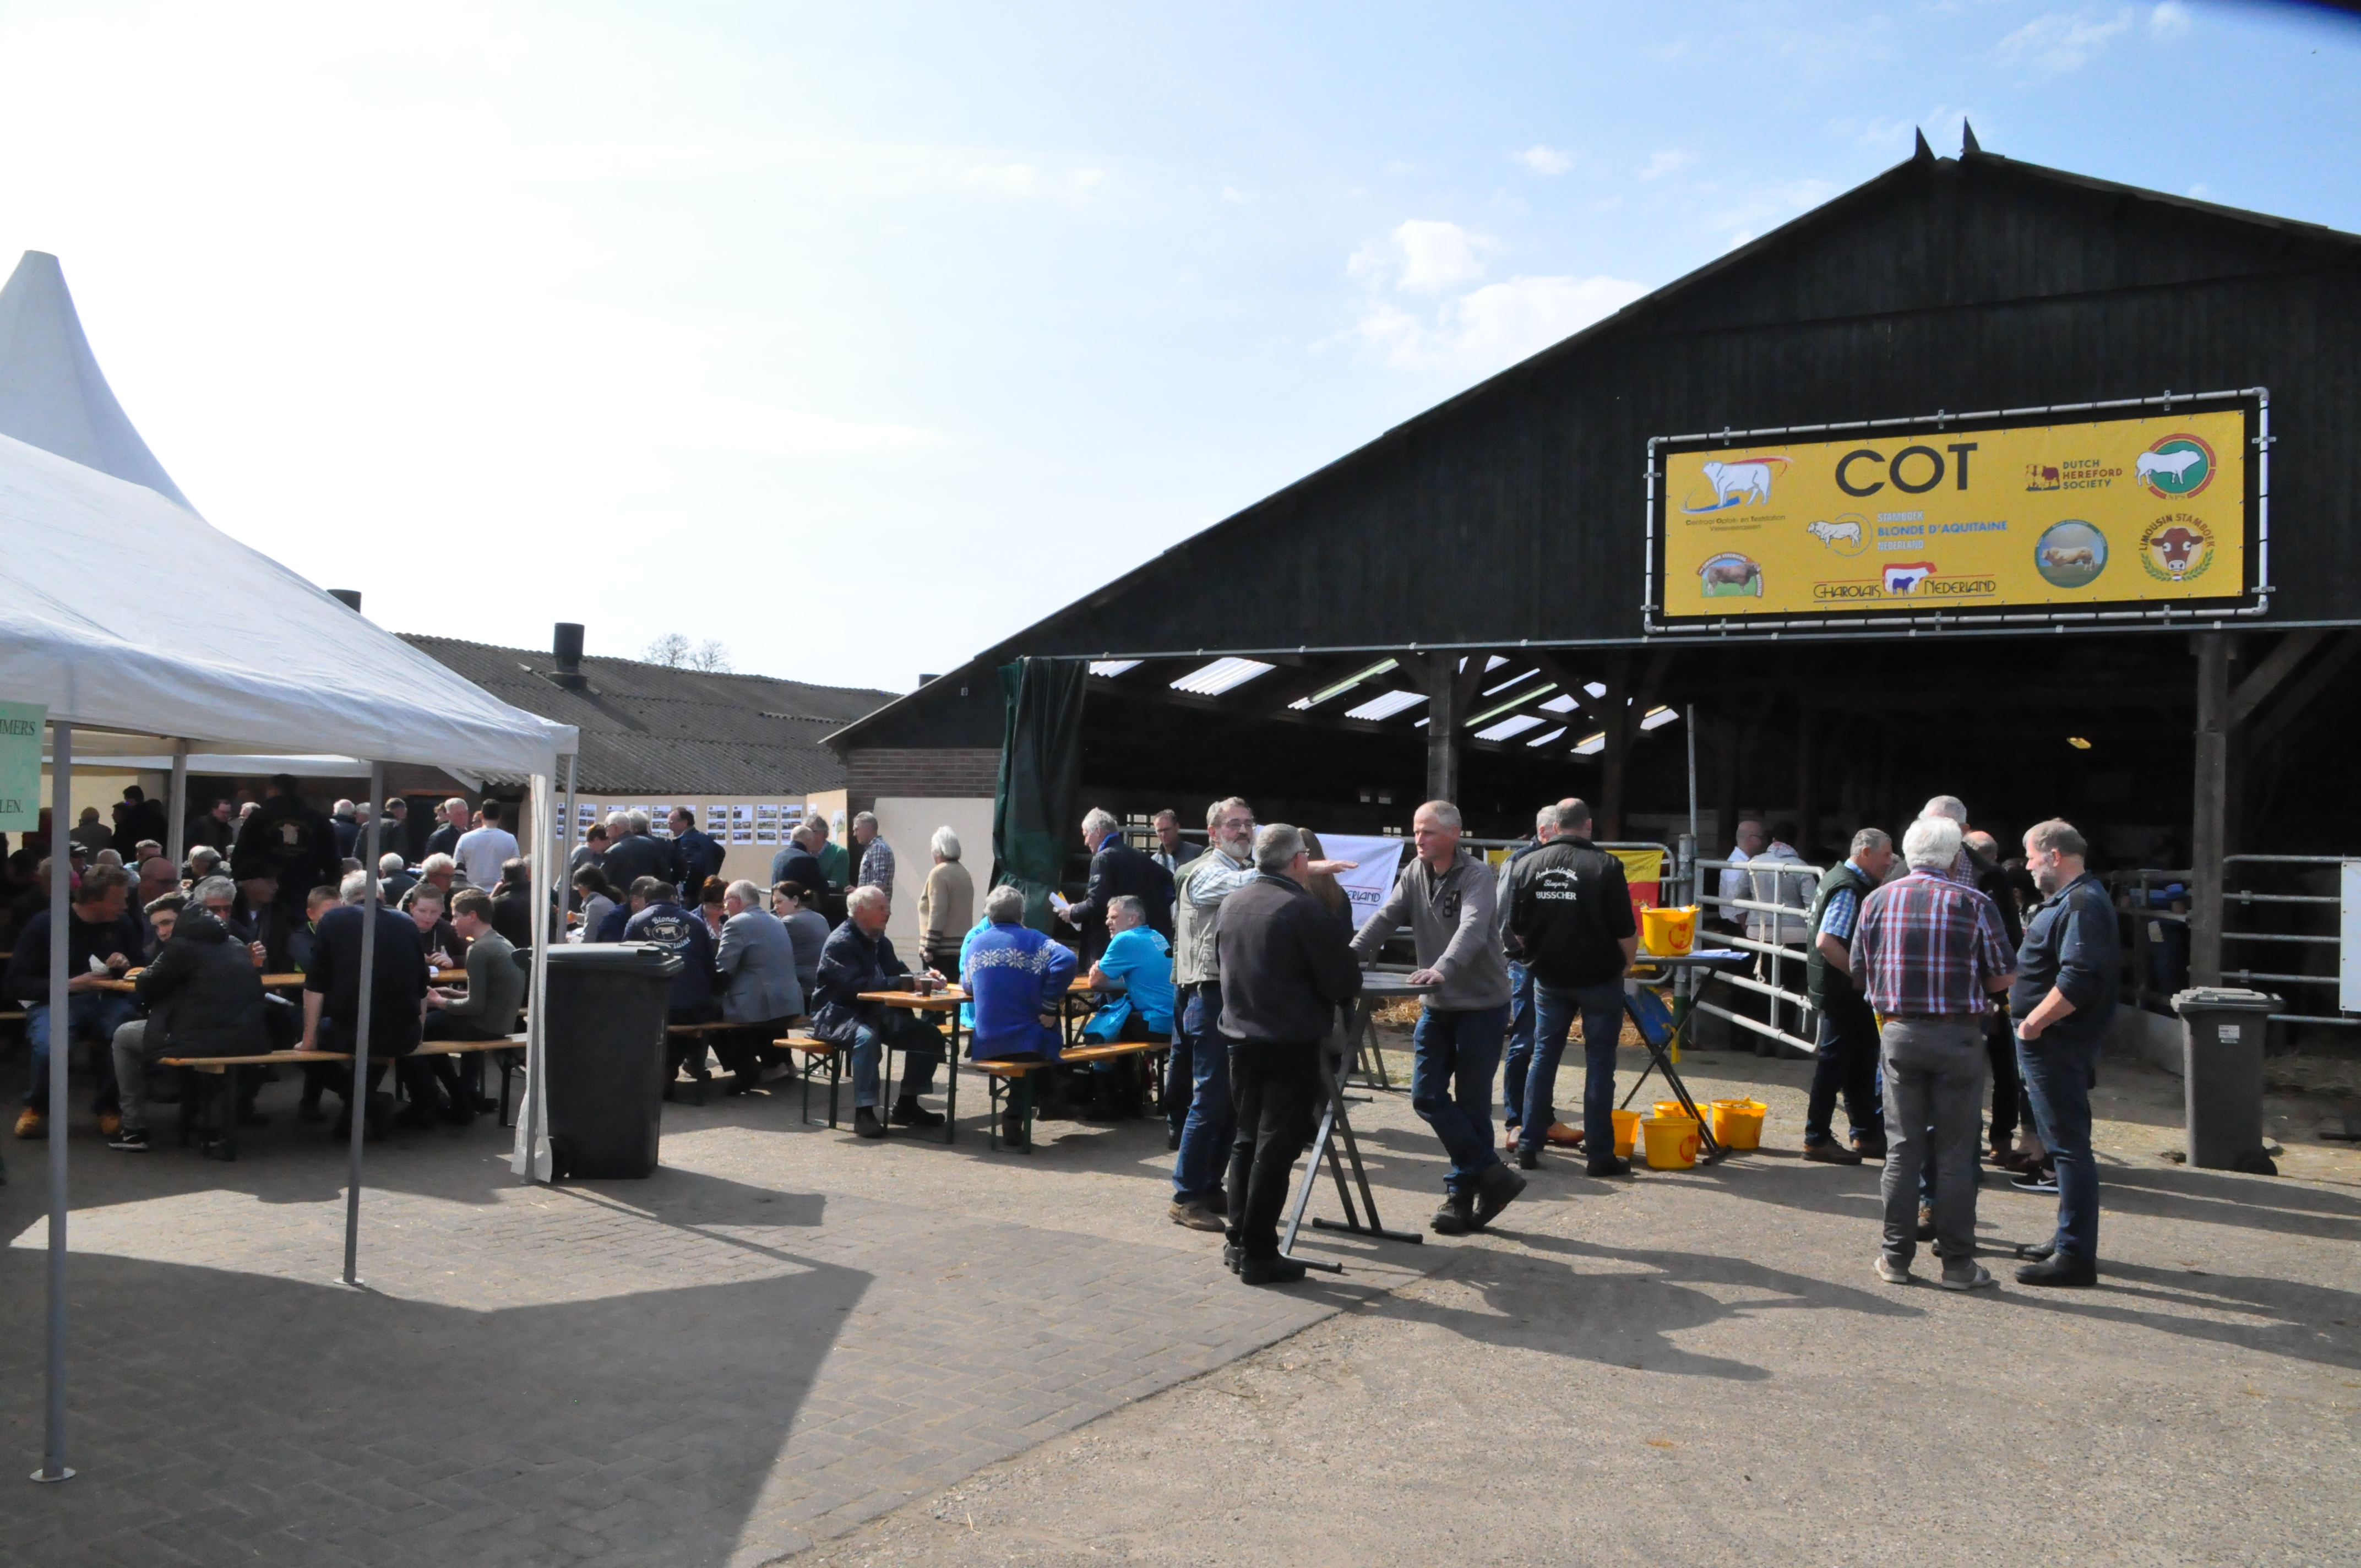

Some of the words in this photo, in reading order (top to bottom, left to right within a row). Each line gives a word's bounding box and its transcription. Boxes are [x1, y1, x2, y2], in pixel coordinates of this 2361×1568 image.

[1835, 443, 1978, 497] COT
[2063, 459, 2100, 469] DUTCH
[2063, 468, 2123, 480] HEREFORD
[2063, 479, 2111, 489] SOCIETY
[1877, 510, 1924, 522] STAMBOEK
[1878, 525, 1925, 537] BLONDE
[1928, 520, 2008, 534] D'AQUITAINE
[2139, 514, 2173, 551] LIMOUSIN
[2175, 513, 2215, 547] STAMBOEK
[1878, 540, 1924, 551] NEDERLAND
[1813, 584, 1881, 598] CHAROLAIS
[1924, 580, 1996, 595] NEDERLAND
[0, 718, 35, 736] MERS
[1535, 891, 1577, 900] BUSSCHER
[651, 916, 680, 924] Blonde
